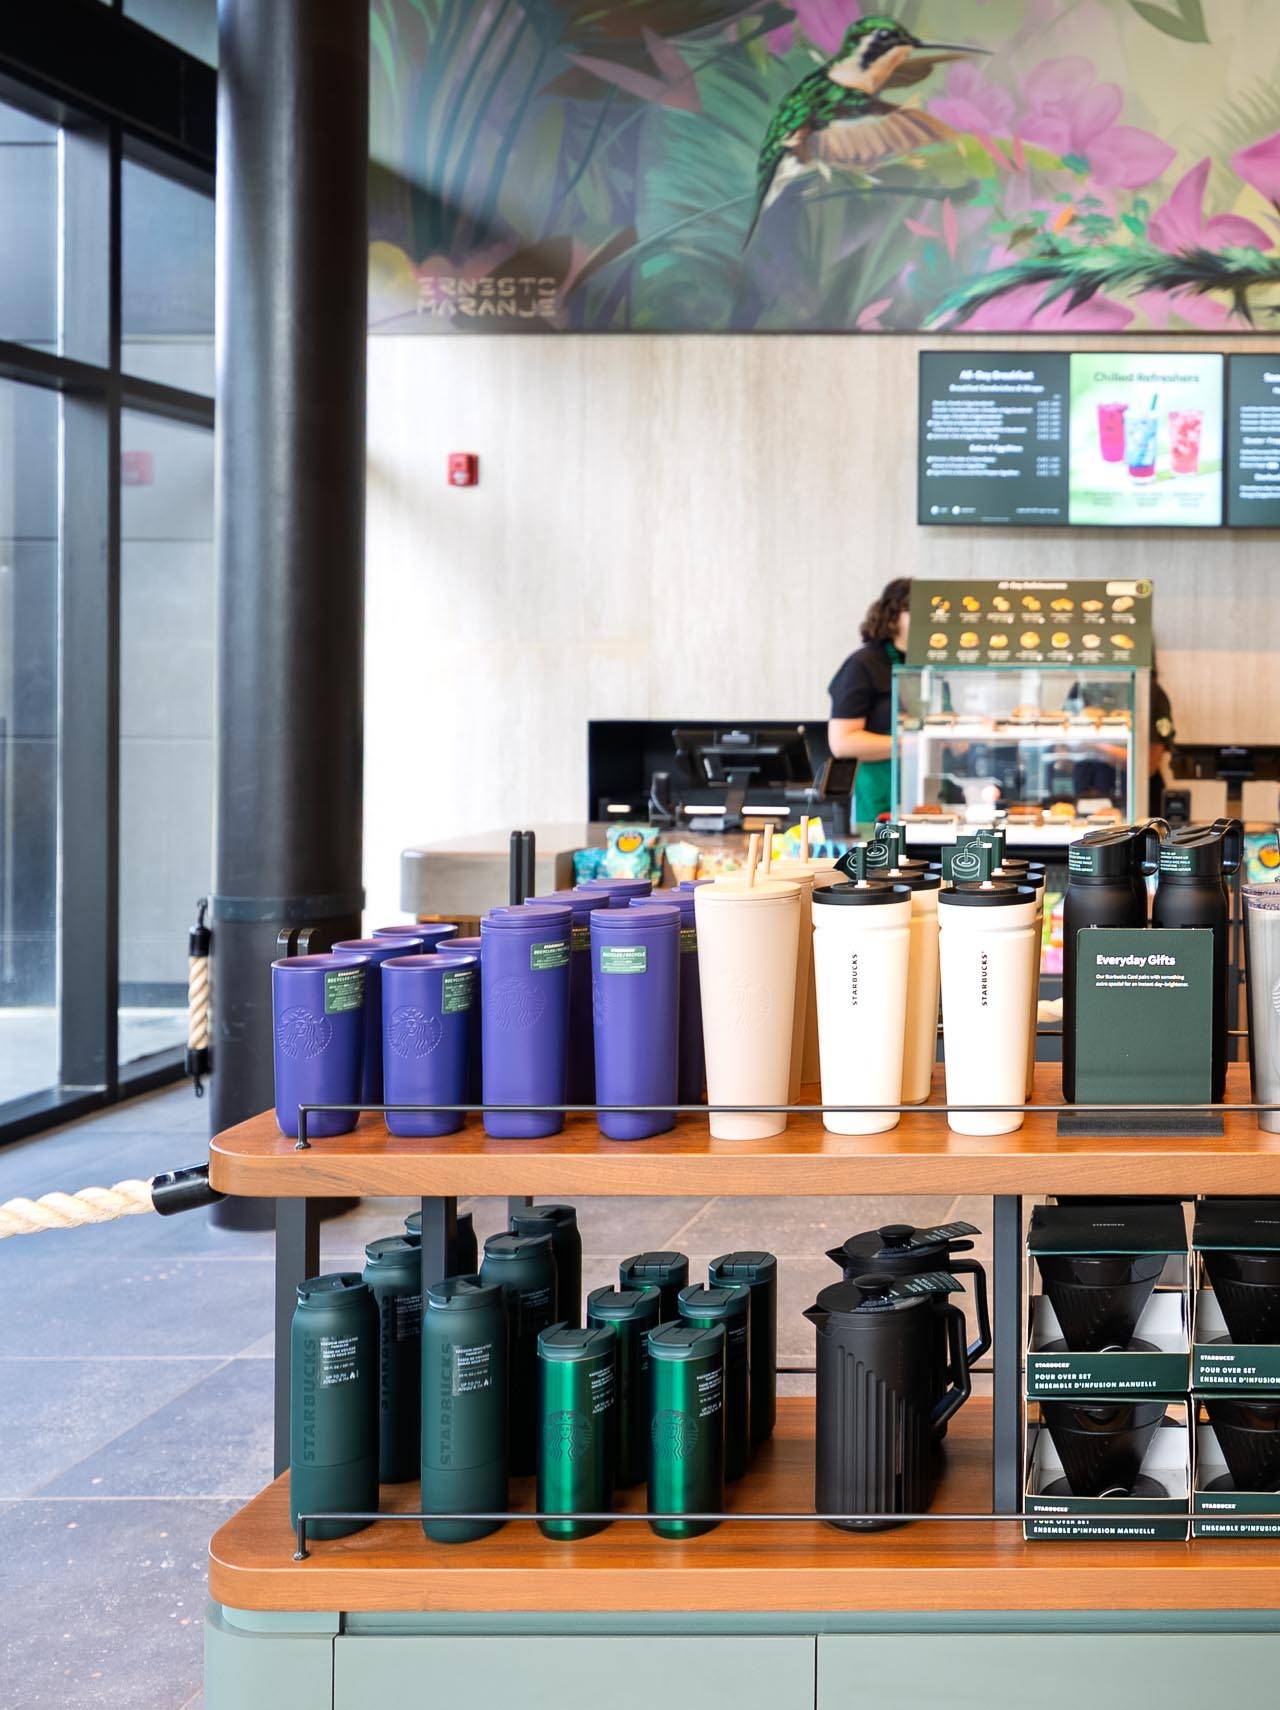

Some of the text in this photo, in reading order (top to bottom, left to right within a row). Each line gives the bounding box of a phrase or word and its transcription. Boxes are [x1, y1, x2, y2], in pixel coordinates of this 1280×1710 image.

[418, 277, 557, 297] ERNESTO
[417, 297, 556, 317] MARANJE
[1094, 371, 1200, 382] Chilled Refreshers
[1096, 954, 1176, 967] Everyday Gifts
[303, 1336, 316, 1463] STARBUCKS
